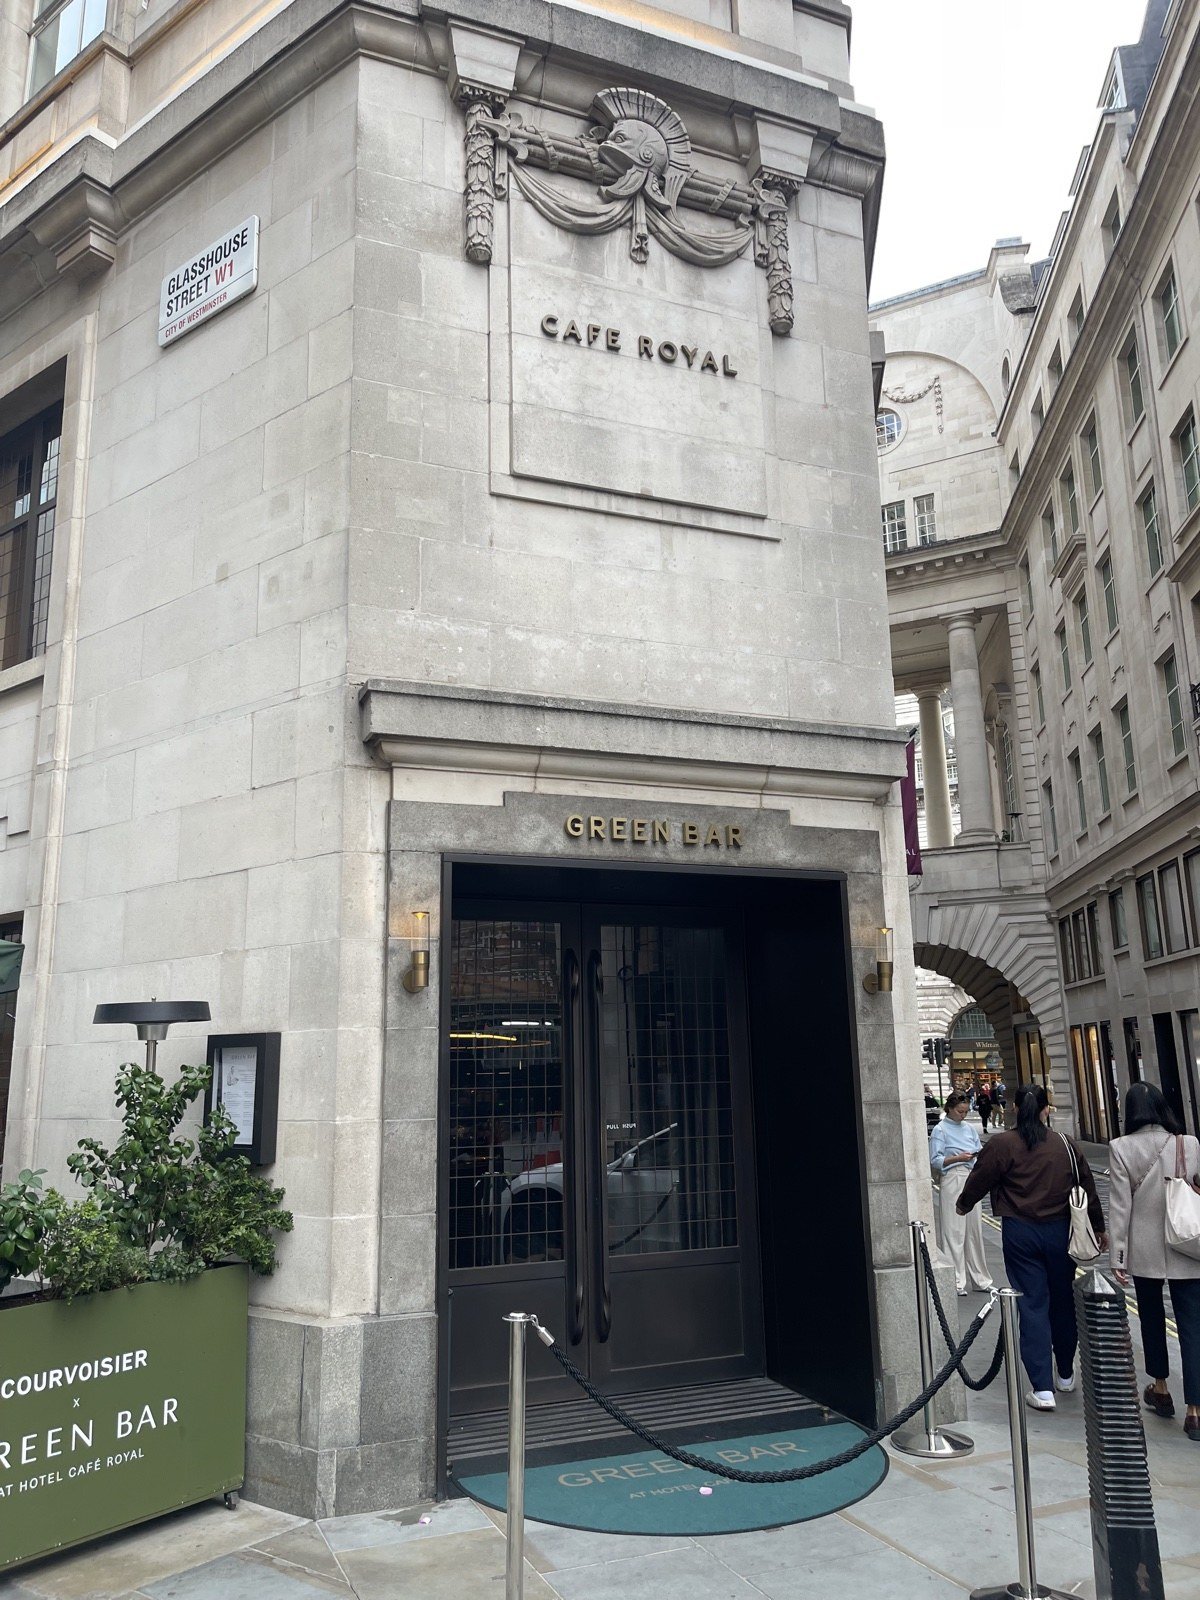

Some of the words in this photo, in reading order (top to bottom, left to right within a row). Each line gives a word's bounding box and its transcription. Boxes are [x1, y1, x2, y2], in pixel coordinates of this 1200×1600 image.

[167, 227, 248, 296] GLASSHOUSE
[166, 274, 211, 318] STREET
[214, 259, 234, 286] W1
[165, 325, 178, 338] CITY
[178, 318, 186, 330] OF
[187, 291, 228, 324] WESTMINSTER
[541, 313, 621, 352] CAFE
[638, 335, 738, 378] ROYAL
[564, 813, 671, 844] GREEN
[682, 821, 743, 849] BAR
[1, 1349, 148, 1399] COURVOISIER
[0, 1420, 94, 1469] REEN
[117, 1398, 179, 1439] BAR
[19, 1471, 63, 1492] HOTEL
[68, 1457, 101, 1478] CAFÉ
[106, 1448, 145, 1467] ROYAL
[557, 1456, 696, 1487] GREE
[716, 1441, 809, 1464] BAR
[630, 1491, 646, 1499] AT
[650, 1483, 698, 1496] HOTEL
